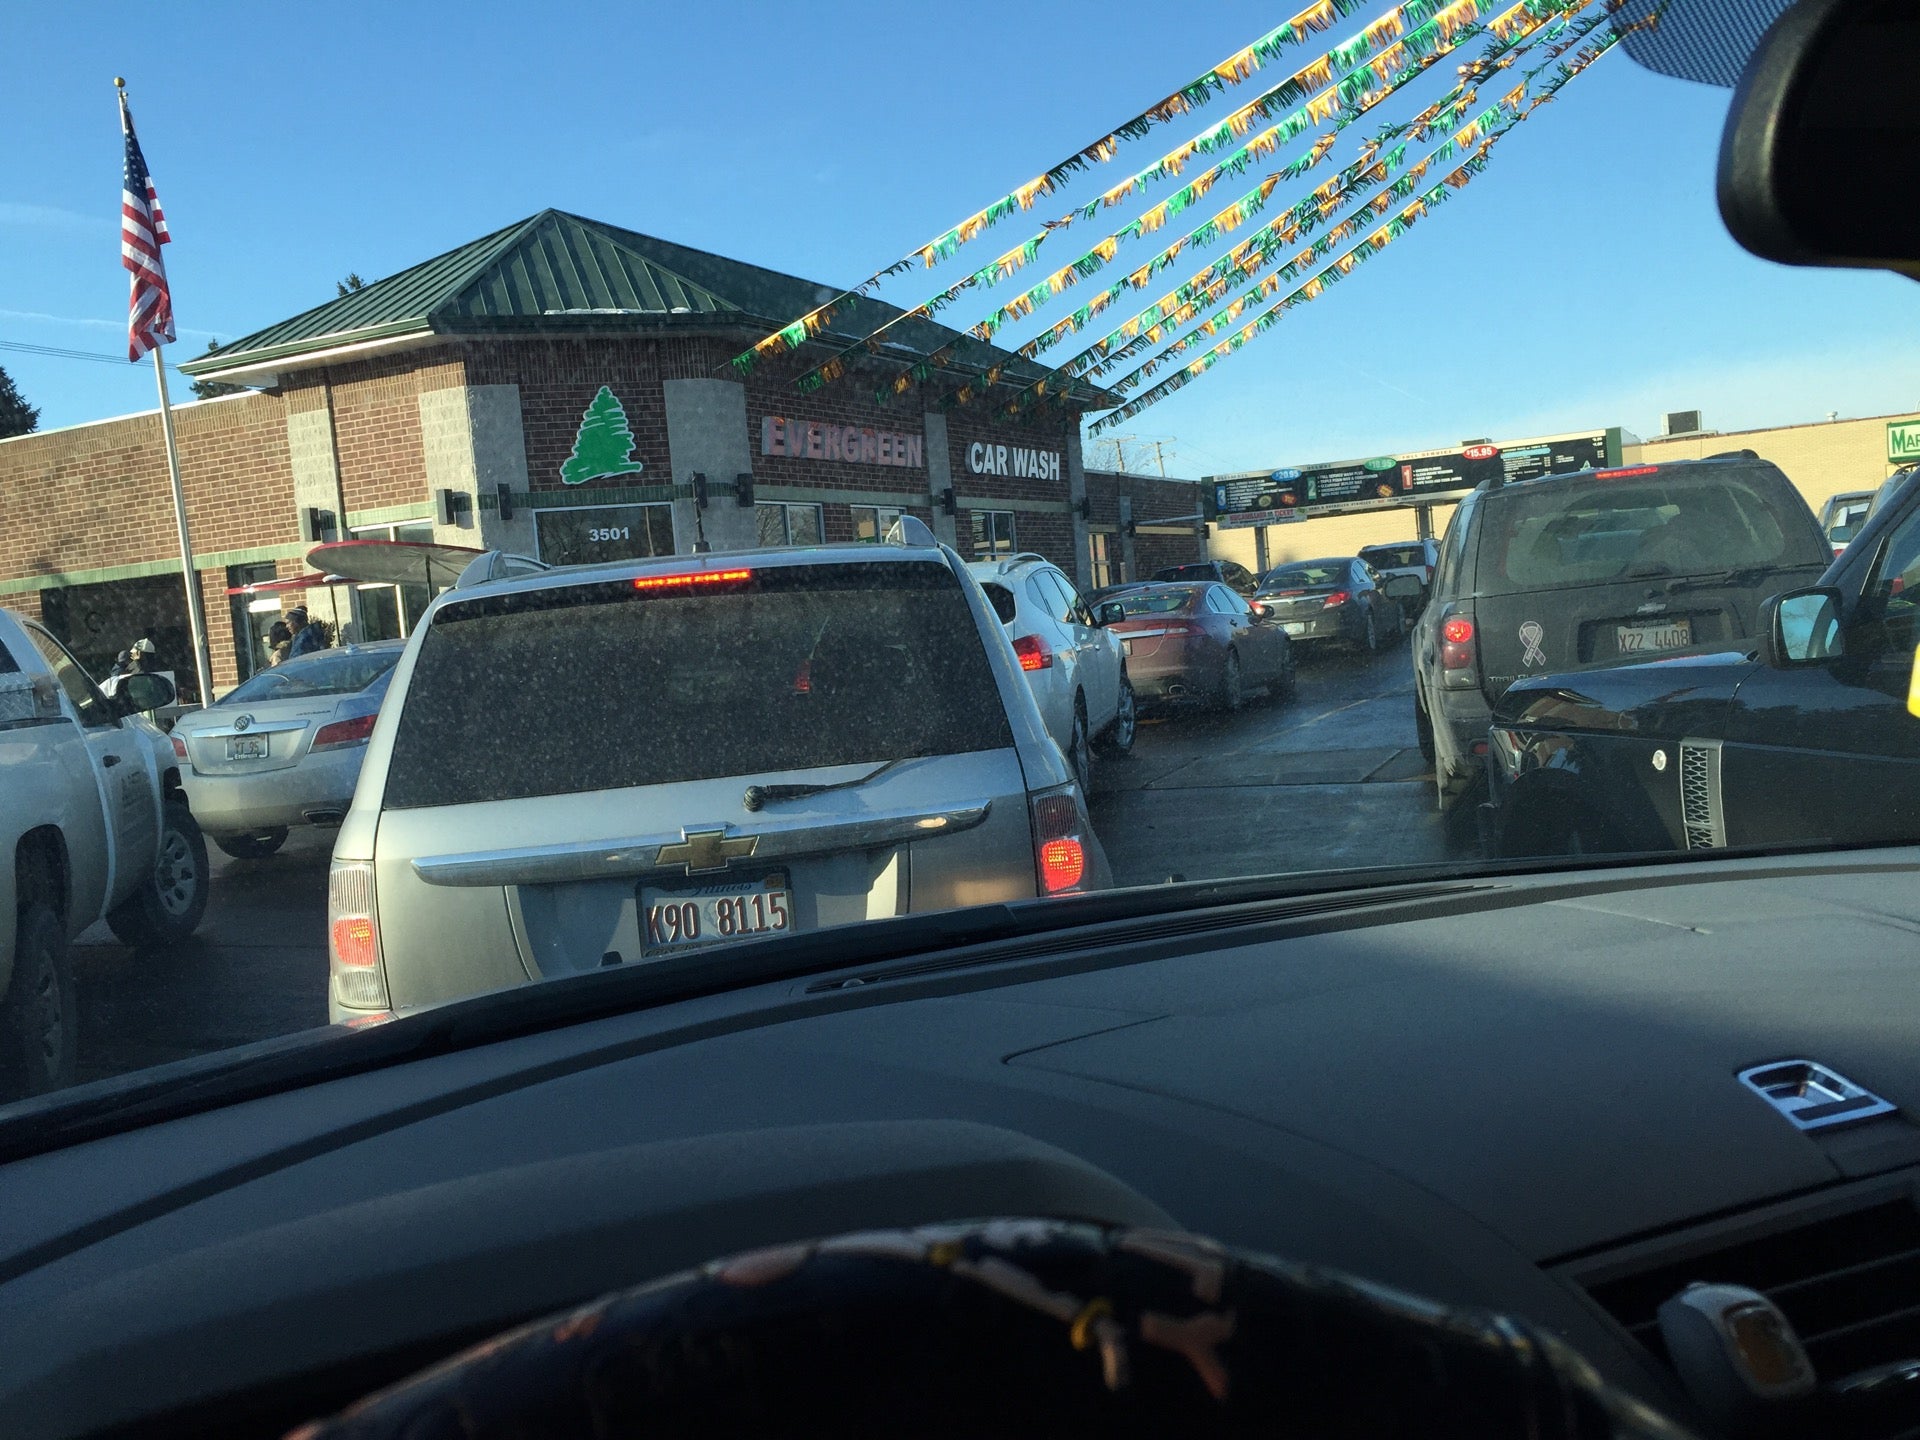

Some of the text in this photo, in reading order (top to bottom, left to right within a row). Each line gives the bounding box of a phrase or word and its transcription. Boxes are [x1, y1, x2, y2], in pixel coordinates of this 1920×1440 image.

[763, 416, 922, 468] EVERGREEN
[970, 441, 1060, 480] CAR WASH
[1467, 446, 1493, 458] $15.95
[1275, 469, 1300, 480] $20.95
[1403, 469, 1411, 486] 1
[1308, 480, 1316, 497] 2
[1217, 489, 1226, 507] 3
[589, 526, 629, 542] 3501
[1619, 629, 1689, 653] X22 4408
[646, 892, 788, 944] K90 8115
